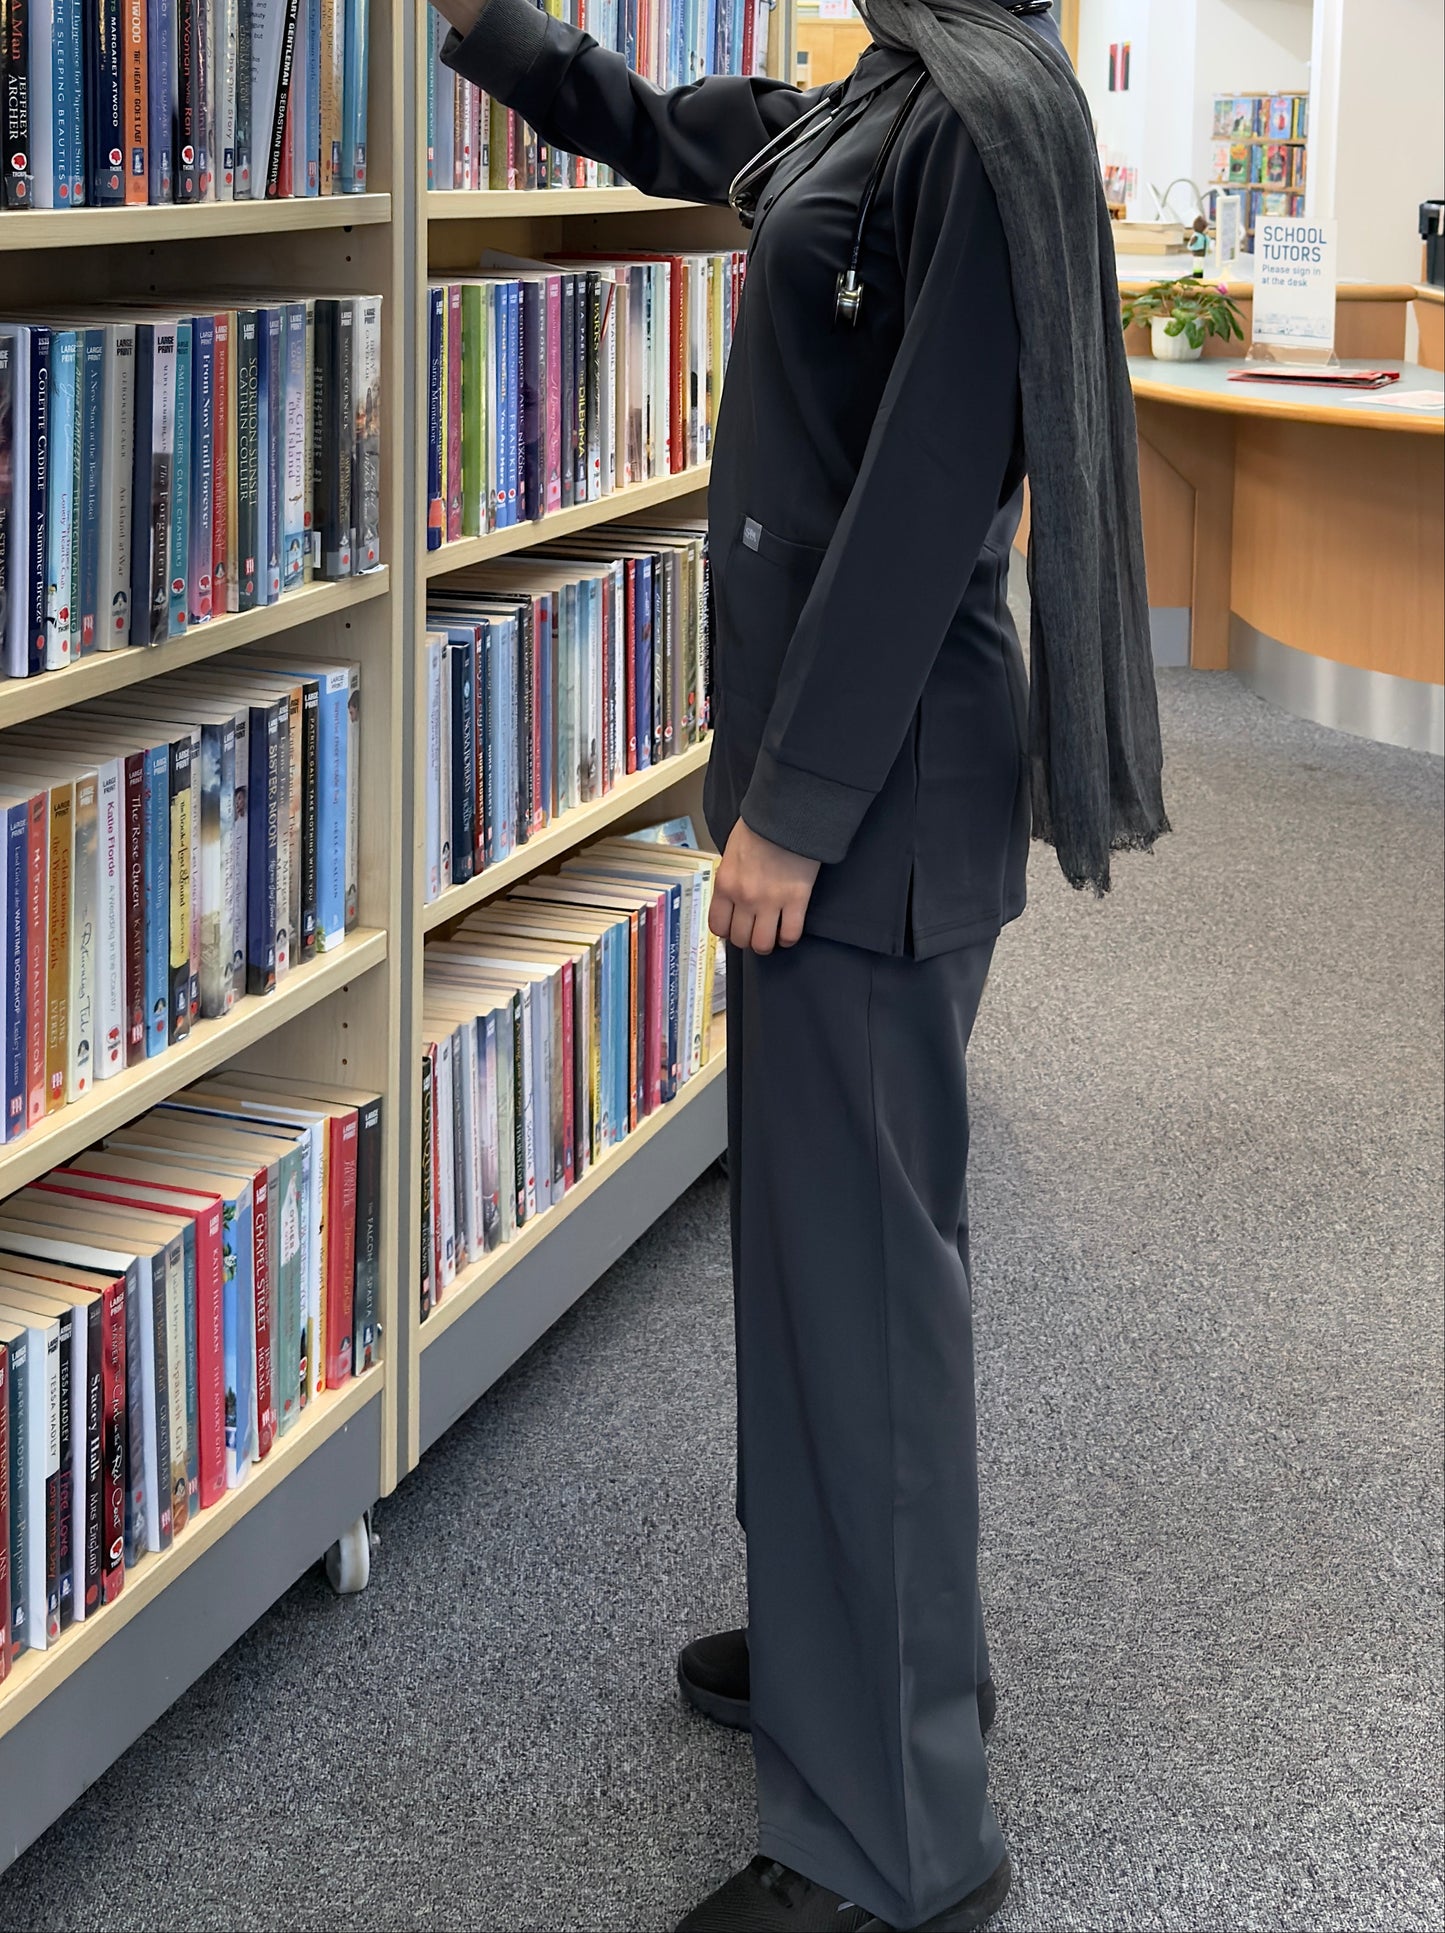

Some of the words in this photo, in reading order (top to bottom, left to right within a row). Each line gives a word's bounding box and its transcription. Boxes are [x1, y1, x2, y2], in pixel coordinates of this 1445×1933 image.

[12, 20, 22, 60] Man
[110, 16, 118, 76] MARGARET
[184, 17, 192, 76] Woman
[282, 22, 296, 86] GENTLEMAN
[57, 32, 65, 102] SLEEPING
[8, 74, 18, 140] ARCHER
[18, 76, 28, 138] JEFFREY
[73, 90, 81, 121] Paper
[184, 106, 192, 136] Ran
[274, 92, 286, 148] SEBASTIAN
[58, 110, 66, 180] BEAUTIES
[73, 148, 81, 180] String
[270, 150, 280, 184] BARRY
[1263, 244, 1321, 262] TUTORS
[1264, 226, 1327, 244] SCHOOL
[1262, 264, 1290, 274] Please
[1293, 266, 1310, 276] sign
[1314, 266, 1320, 276] in
[1272, 277, 1284, 285] the
[1288, 278, 1308, 286] desk
[116, 338, 133, 348] LARGE
[117, 348, 132, 356] PRINT
[158, 336, 174, 345] LARGE
[158, 345, 174, 354] PRINT
[177, 364, 185, 400] SMALL
[202, 354, 211, 394] From
[37, 367, 48, 432] COLETTE
[202, 399, 211, 428] Now
[240, 367, 248, 429] CATRIN
[249, 358, 257, 442] SCORPION
[90, 432, 95, 441] at
[176, 402, 184, 464] PLEASURES
[202, 434, 211, 470] Until
[508, 414, 516, 481] FRANKIE
[37, 435, 47, 491] CADDLE
[159, 464, 168, 486] The
[240, 436, 248, 501] COLLIER
[249, 449, 257, 506] SUNSET
[59, 493, 67, 525] Lonely
[119, 486, 127, 502] An
[202, 473, 211, 529] Forever
[37, 511, 44, 519] A
[119, 506, 127, 538] Island
[156, 491, 168, 576] Forgotten
[36, 524, 45, 575] Summer
[119, 543, 125, 553] at
[175, 508, 183, 567] CHAMBERS
[117, 555, 125, 576] War
[36, 581, 44, 623] Breeze
[268, 744, 278, 800] SISTER
[107, 801, 115, 833] Katie
[132, 795, 141, 822] The
[268, 802, 277, 848] NOON
[132, 825, 141, 859] Rose
[109, 885, 116, 894] A
[132, 863, 141, 909] Queen
[108, 896, 116, 940] Wedding
[133, 919, 141, 958] KATIE
[50, 938, 58, 970] Girls
[109, 943, 116, 951] in
[109, 954, 117, 971] the
[109, 973, 117, 1013] Country
[58, 999, 66, 1043] ELAINE
[33, 1023, 41, 1075] ELTON
[422, 1091, 430, 1213] CONQUEST
[255, 1213, 264, 1276] CHAPEL
[212, 1288, 220, 1353] HICKMAN
[256, 1281, 265, 1333] STREET
[172, 1361, 182, 1420] Spanish
[257, 1347, 265, 1400] HOLMES
[16, 1377, 24, 1418] MARK
[88, 1374, 100, 1432] Stacey
[16, 1424, 24, 1489] HADDON
[90, 1438, 100, 1482] Halls
[173, 1426, 183, 1458] Girl
[49, 1478, 57, 1507] Late
[59, 1471, 70, 1508] Free
[60, 1516, 70, 1557] Love
[88, 1526, 98, 1575] England
[47, 1553, 57, 1579] Day
